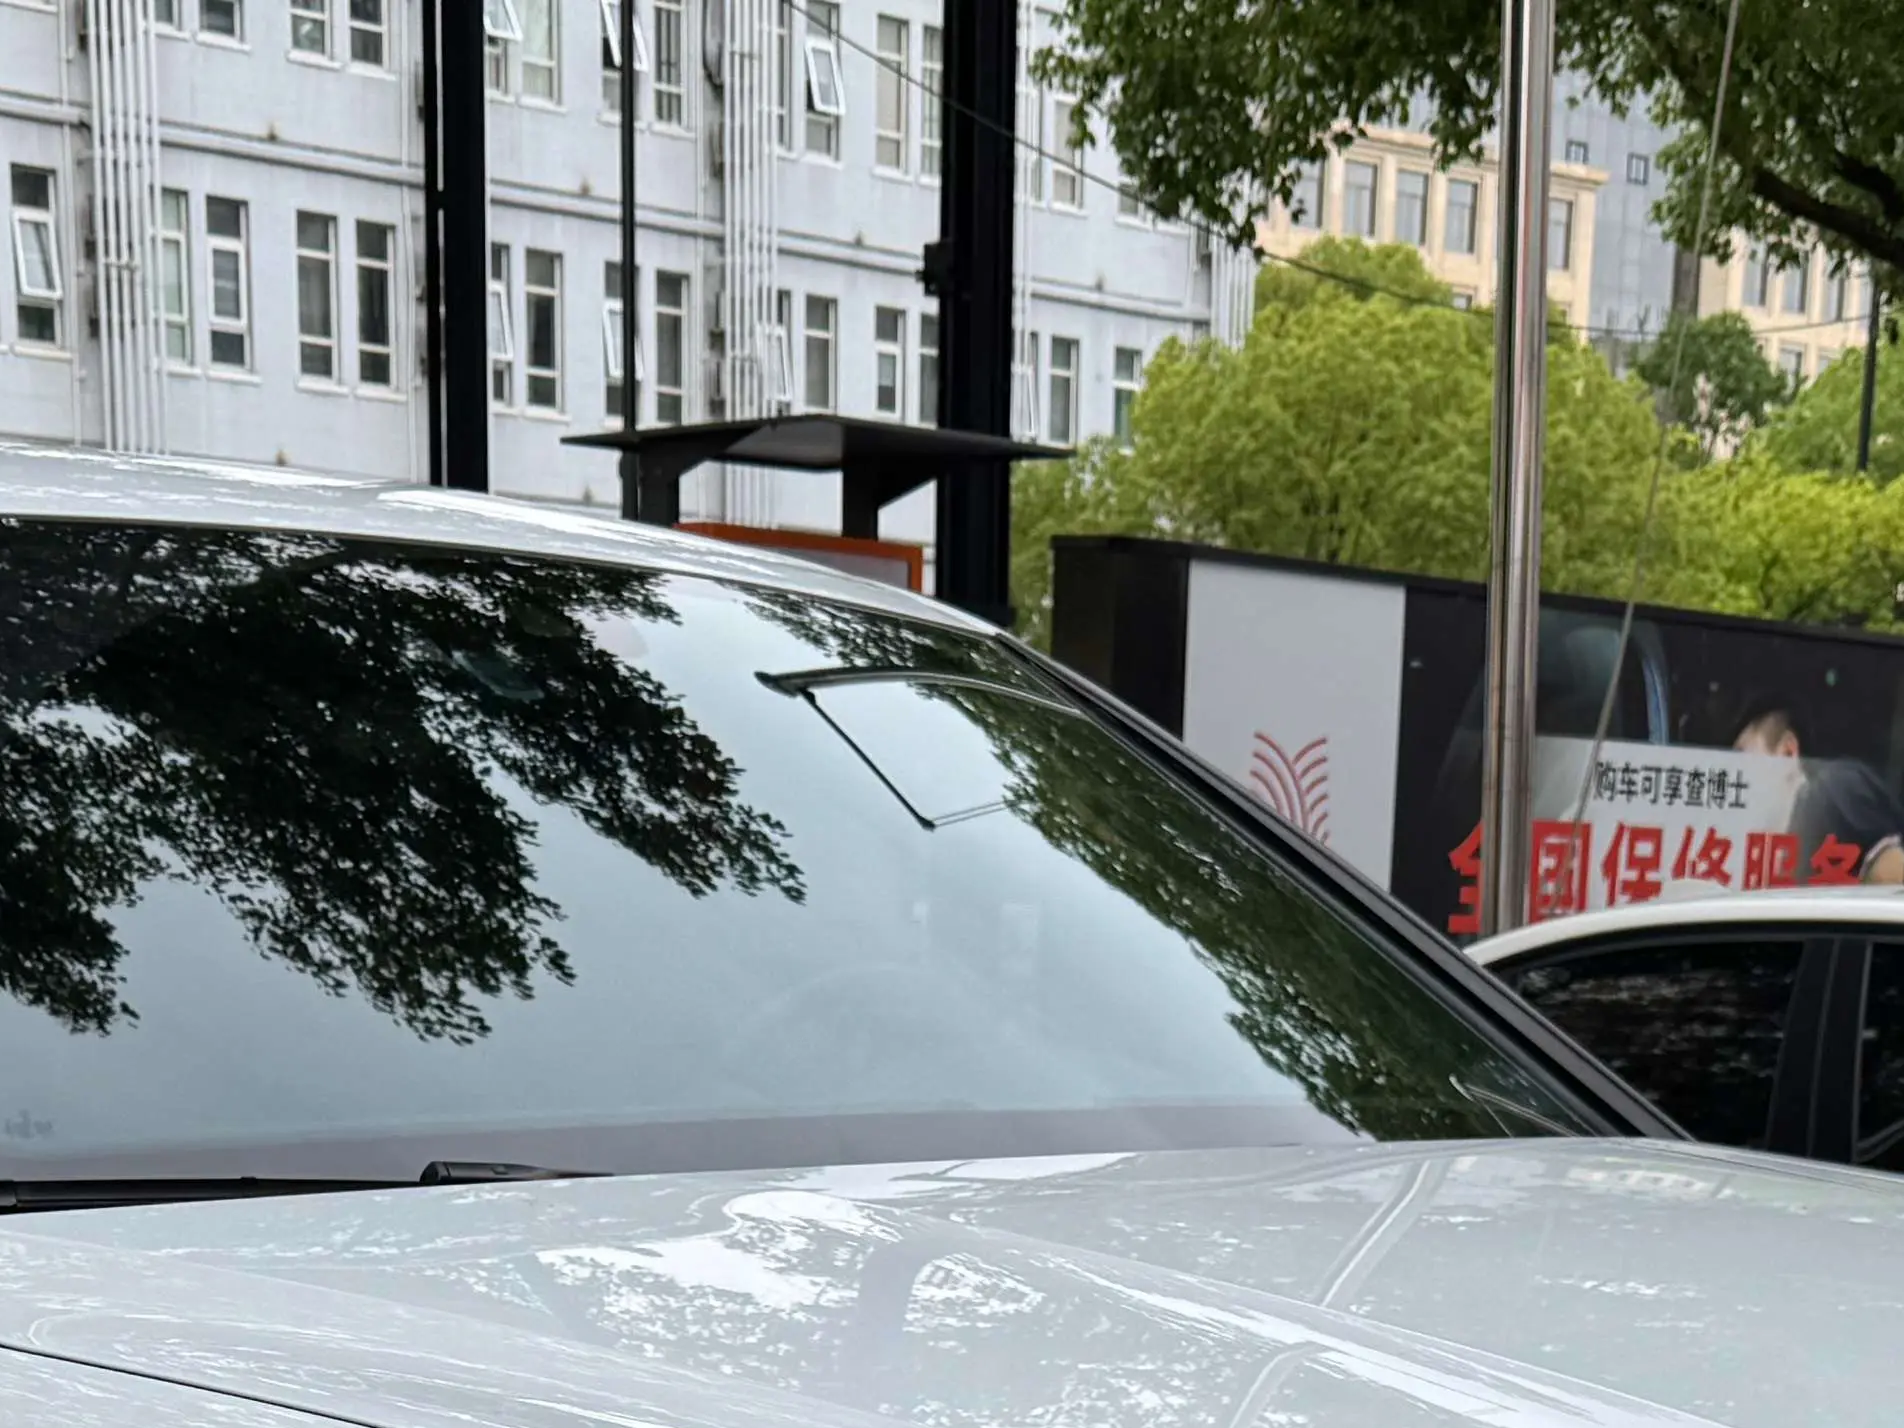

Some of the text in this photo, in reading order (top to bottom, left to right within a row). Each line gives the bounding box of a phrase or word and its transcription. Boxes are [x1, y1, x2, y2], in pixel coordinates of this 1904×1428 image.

[1594, 760, 1750, 810] 购车可享查博士
